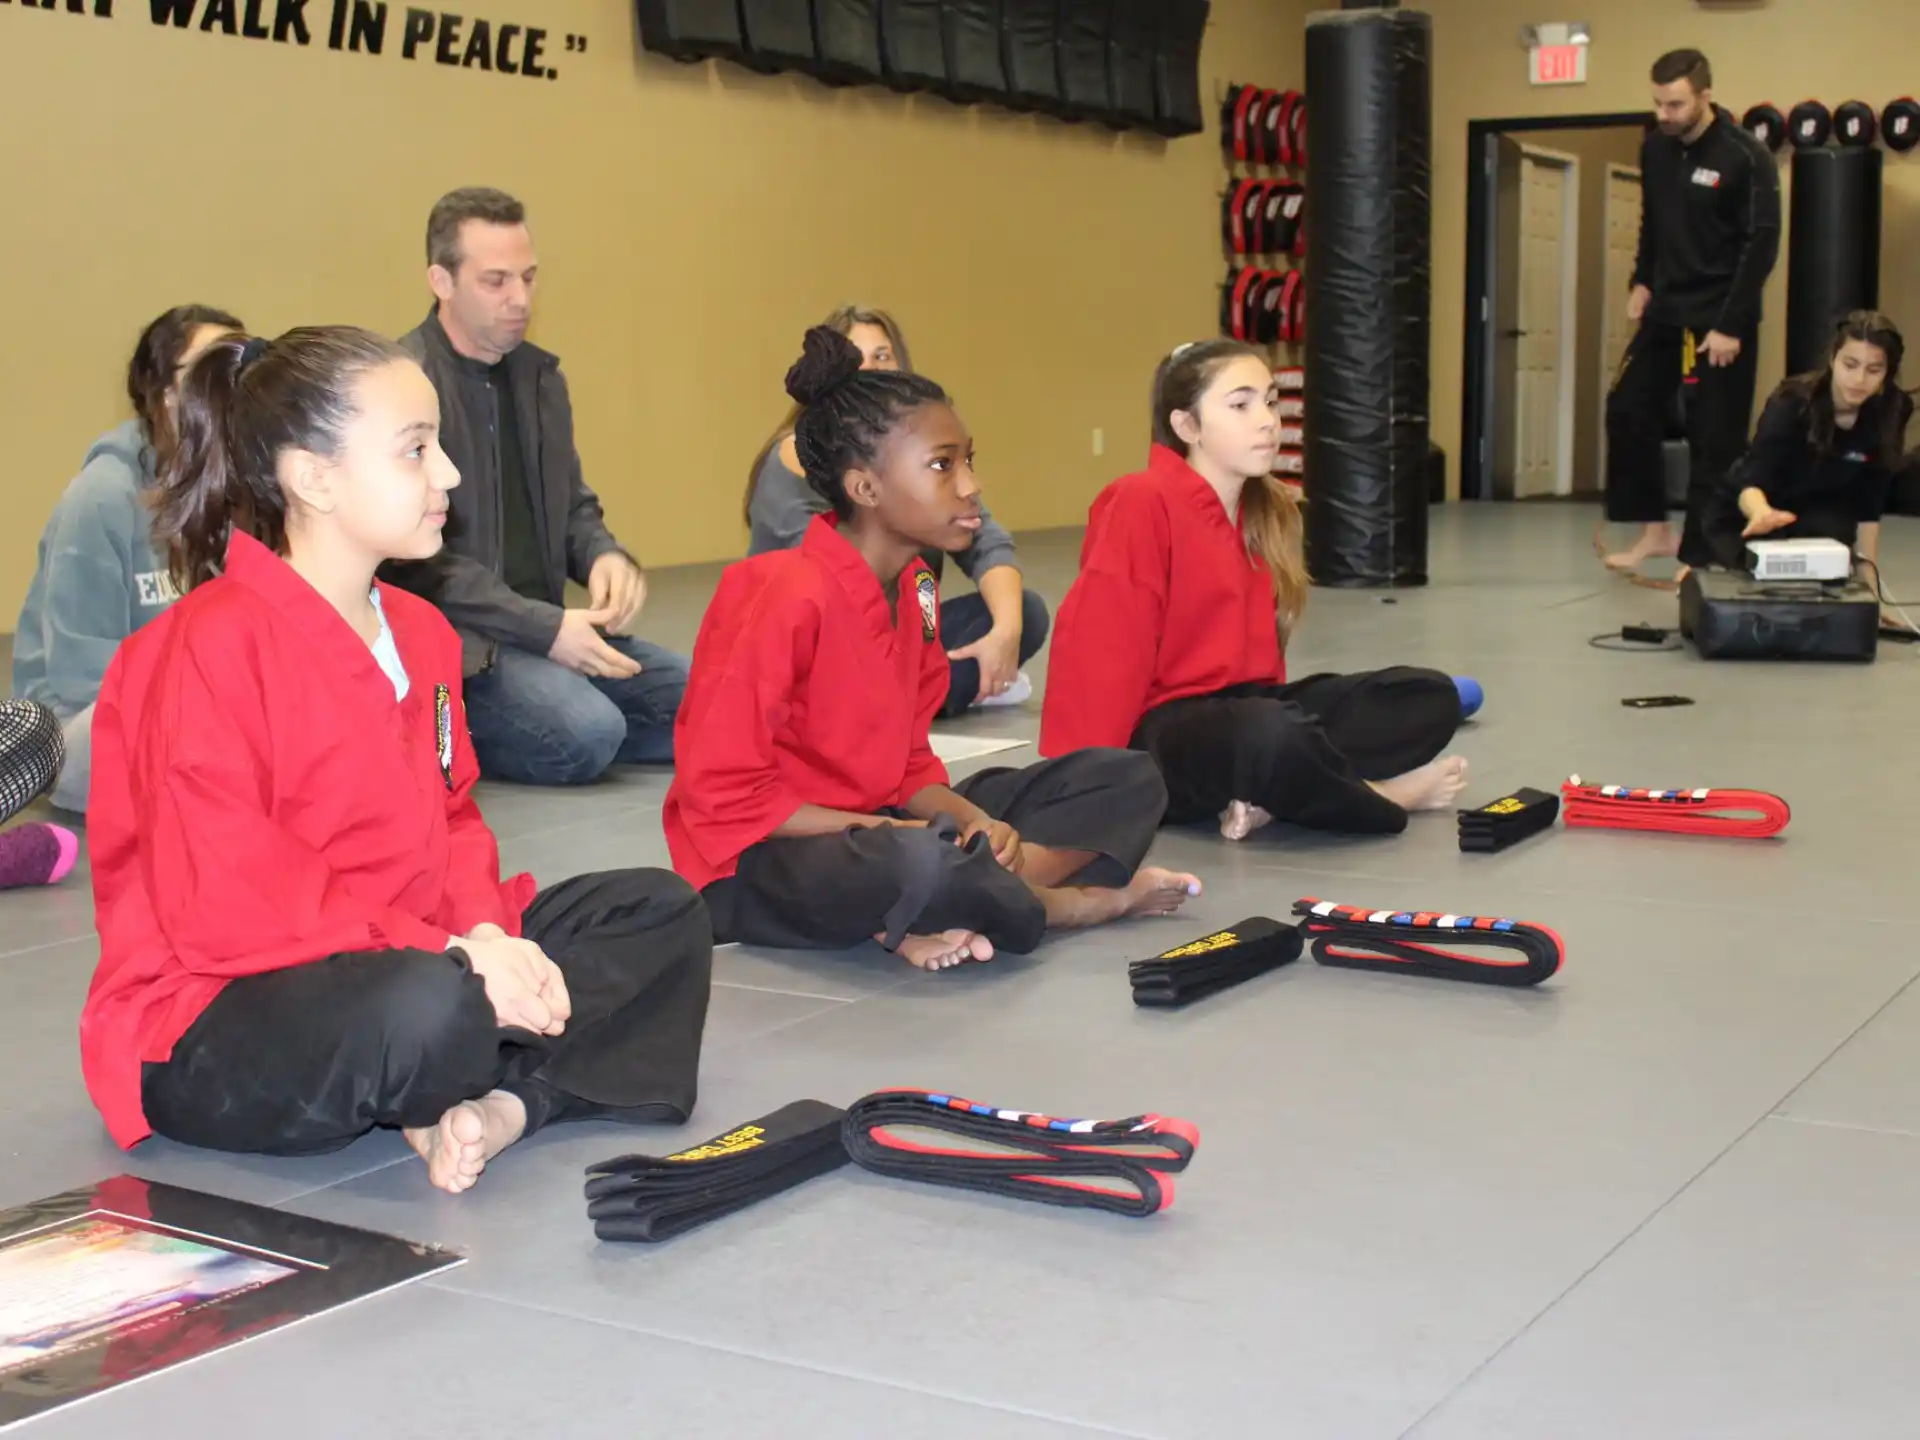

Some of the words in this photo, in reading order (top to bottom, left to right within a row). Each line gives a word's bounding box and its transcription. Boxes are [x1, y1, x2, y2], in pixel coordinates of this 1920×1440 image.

[150, 0, 311, 46] WALK
[328, 0, 387, 55] IN
[1538, 45, 1579, 81] EXIT
